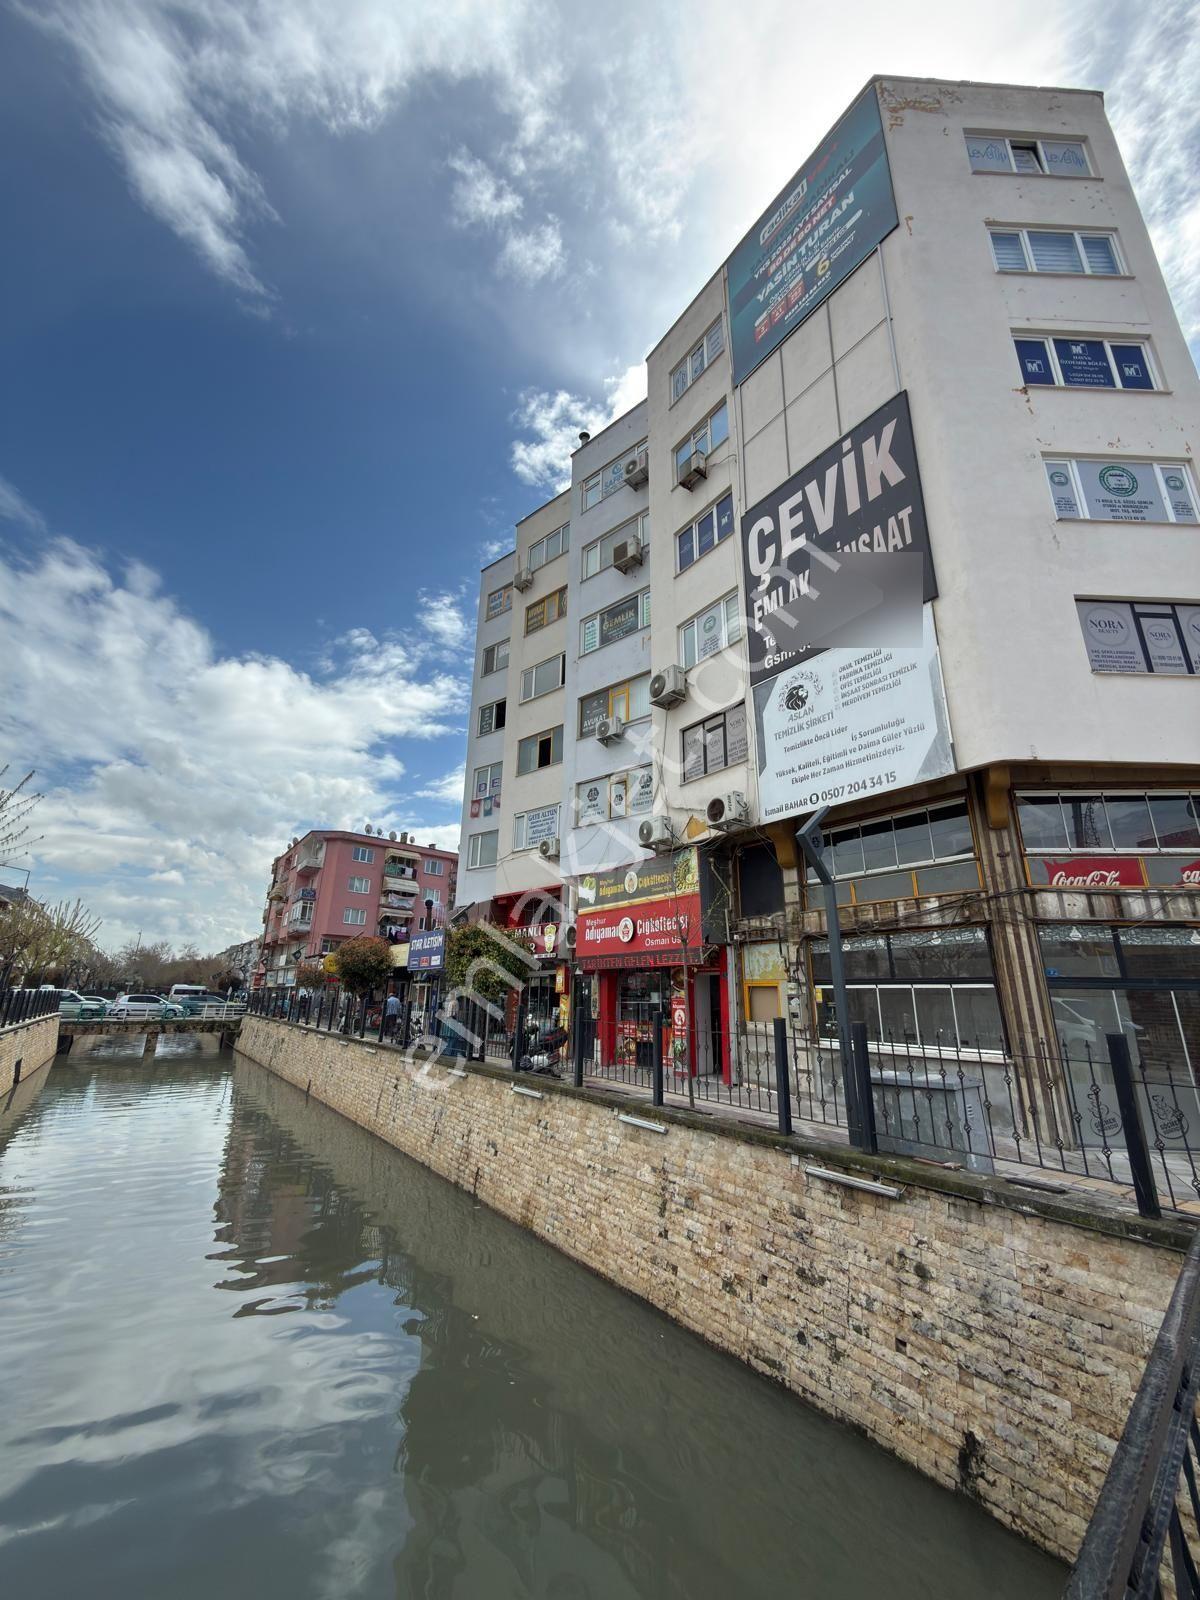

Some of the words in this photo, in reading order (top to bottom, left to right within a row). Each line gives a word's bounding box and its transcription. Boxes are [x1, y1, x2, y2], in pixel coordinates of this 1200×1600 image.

[813, 195, 834, 225] NET
[756, 250, 797, 306] YASİN
[798, 189, 854, 259] TURAN
[816, 251, 830, 279] 6
[748, 417, 906, 591] ÇEVİK
[836, 505, 913, 553] AAT
[1089, 619, 1124, 630] NORA
[838, 661, 852, 673] OKUL
[853, 647, 881, 666] TEMİZLİĞİ
[839, 666, 862, 681] FABRİKA
[863, 652, 892, 671] TEMİZLİĞİ
[840, 679, 853, 690] OFİS
[853, 666, 881, 685] TEMİZLİĞİ
[841, 685, 861, 699] İNŞAAT
[861, 674, 887, 690] SONRASI
[889, 661, 917, 679] TEMİZLİK
[841, 690, 870, 707] MERDİVEN
[872, 677, 901, 696] TEMİZLİĞİ
[774, 720, 804, 741] TEMİZLİK
[805, 709, 833, 730] ŞİRKETİ
[787, 704, 813, 723] ASLAN
[784, 736, 813, 753] Temizlikte
[814, 729, 829, 742] Öncü
[831, 724, 847, 736] Lider
[851, 731, 857, 742] İş
[858, 715, 905, 739] Sorumluluğu
[775, 765, 797, 779] Yüksek,
[798, 757, 821, 772] Kaliteli,
[822, 748, 847, 764] Eğitimli
[848, 746, 856, 754] ve
[858, 738, 880, 751] Daima
[881, 730, 902, 743] Güler
[903, 722, 925, 736] Yüzlü
[791, 773, 809, 786] Ekiple
[810, 769, 821, 779] Her
[822, 762, 844, 775] Zaman
[845, 742, 904, 769] Hizmetinizdeyiz.
[765, 803, 783, 816] İsmail
[784, 797, 807, 811] BAHAR
[821, 785, 844, 801] 0507
[846, 779, 866, 794] 204
[869, 774, 884, 787] 34
[885, 770, 896, 783] 15
[1052, 870, 1120, 886] Coca-Cola
[585, 925, 621, 943] Adıyaman
[586, 918, 606, 926] Meşhur
[645, 937, 670, 947] Osman
